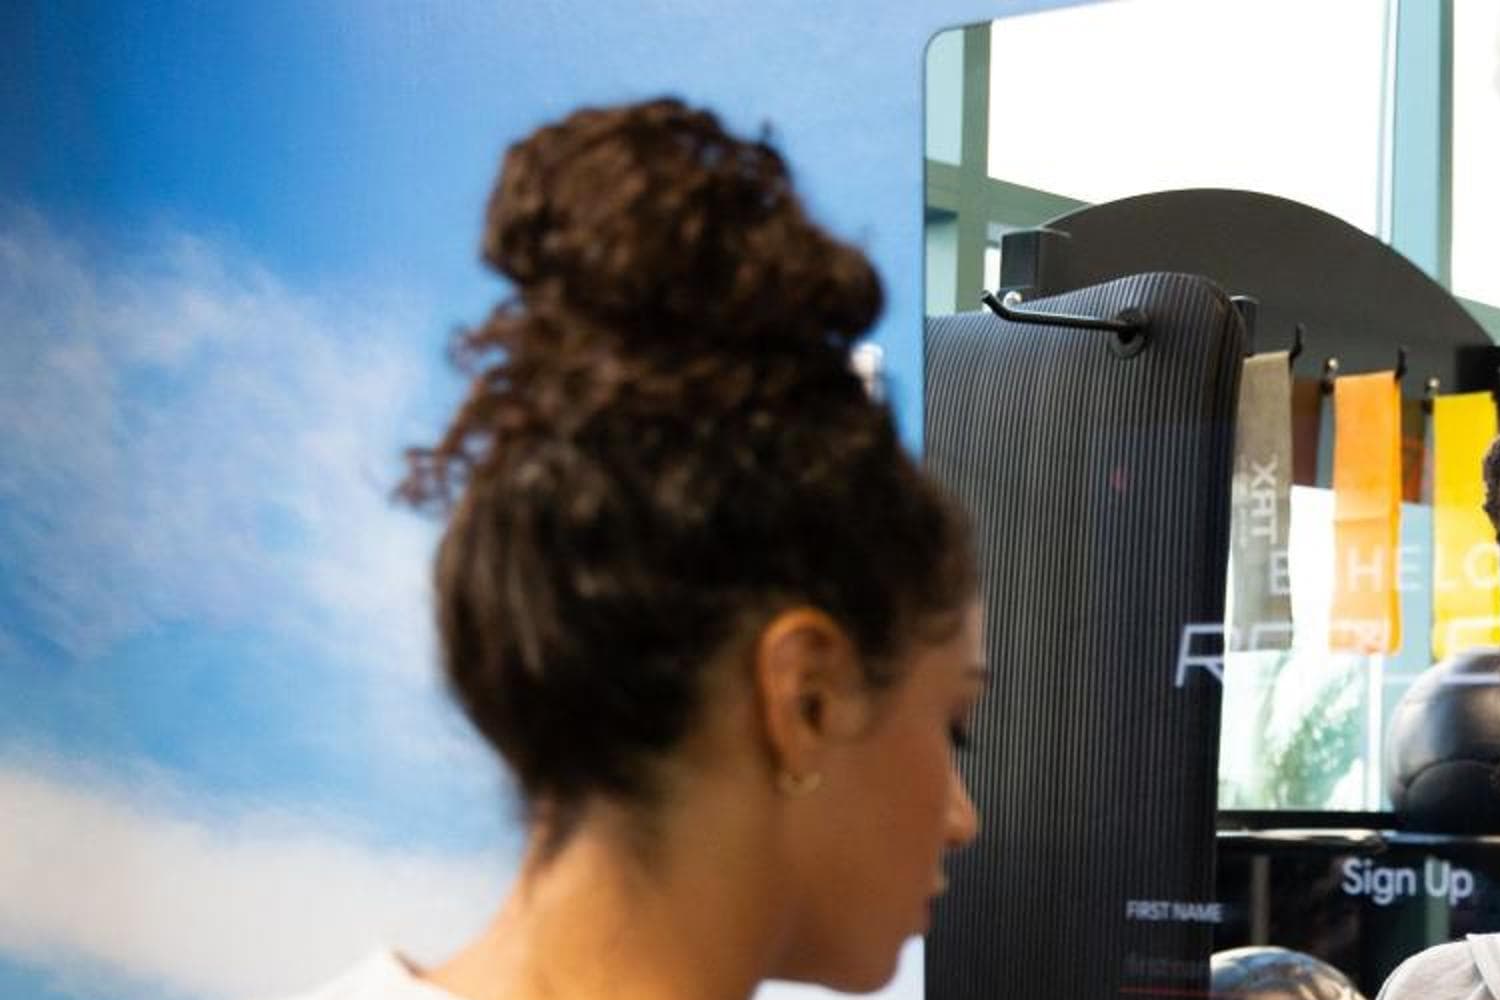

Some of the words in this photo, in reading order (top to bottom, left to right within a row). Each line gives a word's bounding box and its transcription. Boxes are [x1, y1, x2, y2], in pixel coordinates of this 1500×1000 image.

[1342, 858, 1417, 905] Sign
[1425, 859, 1474, 906] Up
[1126, 900, 1172, 921] FIRST
[1173, 903, 1223, 924] NAME
